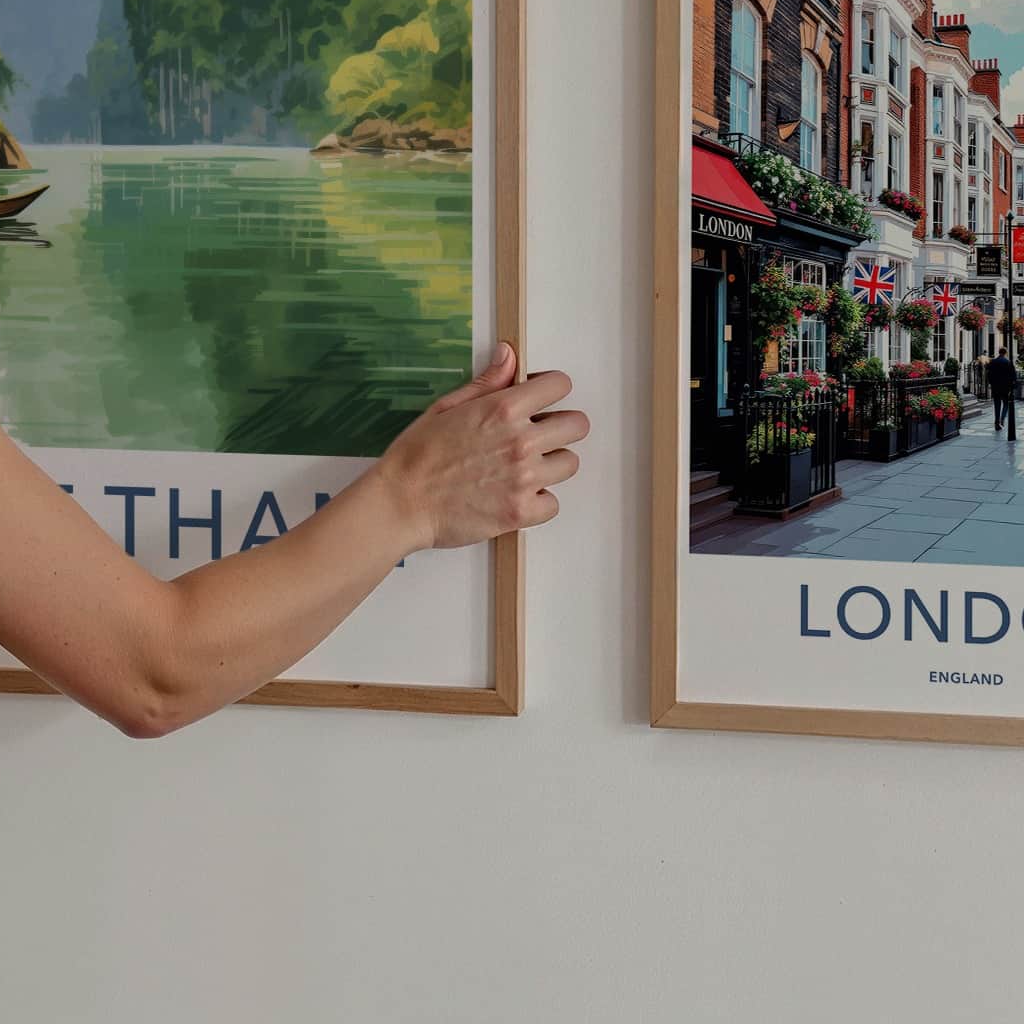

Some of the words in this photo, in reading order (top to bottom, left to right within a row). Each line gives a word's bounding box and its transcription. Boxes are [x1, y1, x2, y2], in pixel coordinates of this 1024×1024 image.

[698, 213, 753, 242] LONDON
[800, 584, 1024, 645] LOND
[929, 670, 1004, 686] ENGLAND
